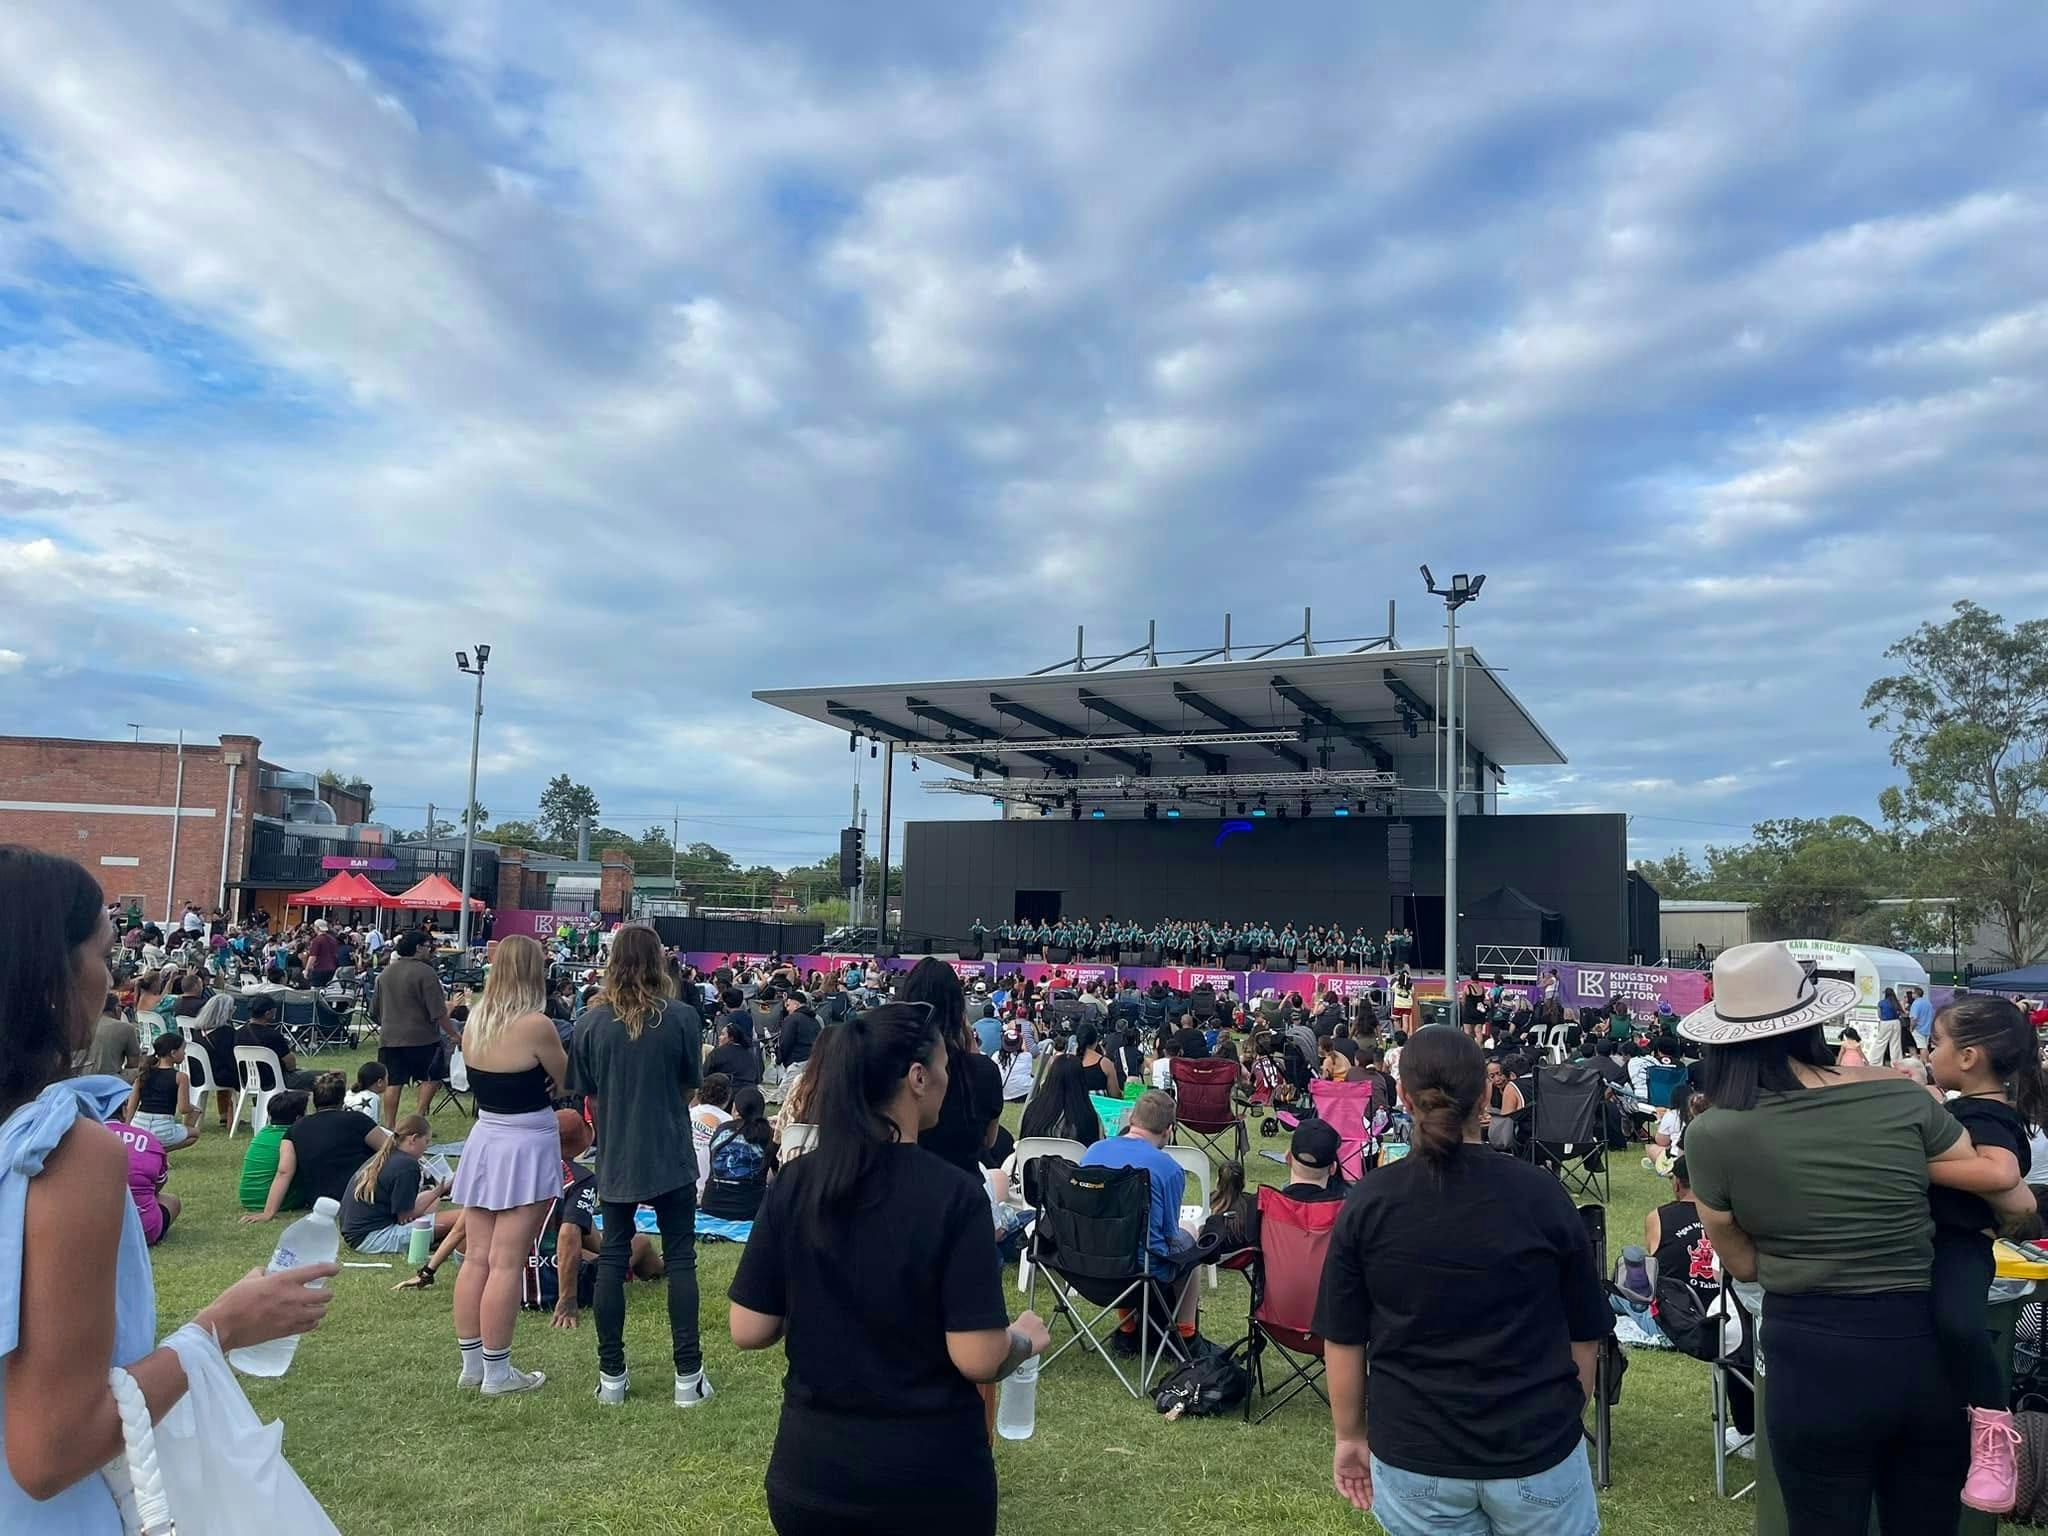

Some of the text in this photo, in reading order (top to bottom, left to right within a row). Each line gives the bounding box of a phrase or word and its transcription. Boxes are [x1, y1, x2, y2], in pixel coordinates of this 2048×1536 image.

[556, 915, 592, 923] KINGSTO
[1789, 941, 1852, 956] KAVA INFUSIONS
[1610, 972, 1668, 983] KINGSTON
[1610, 981, 1653, 992] BUTTER
